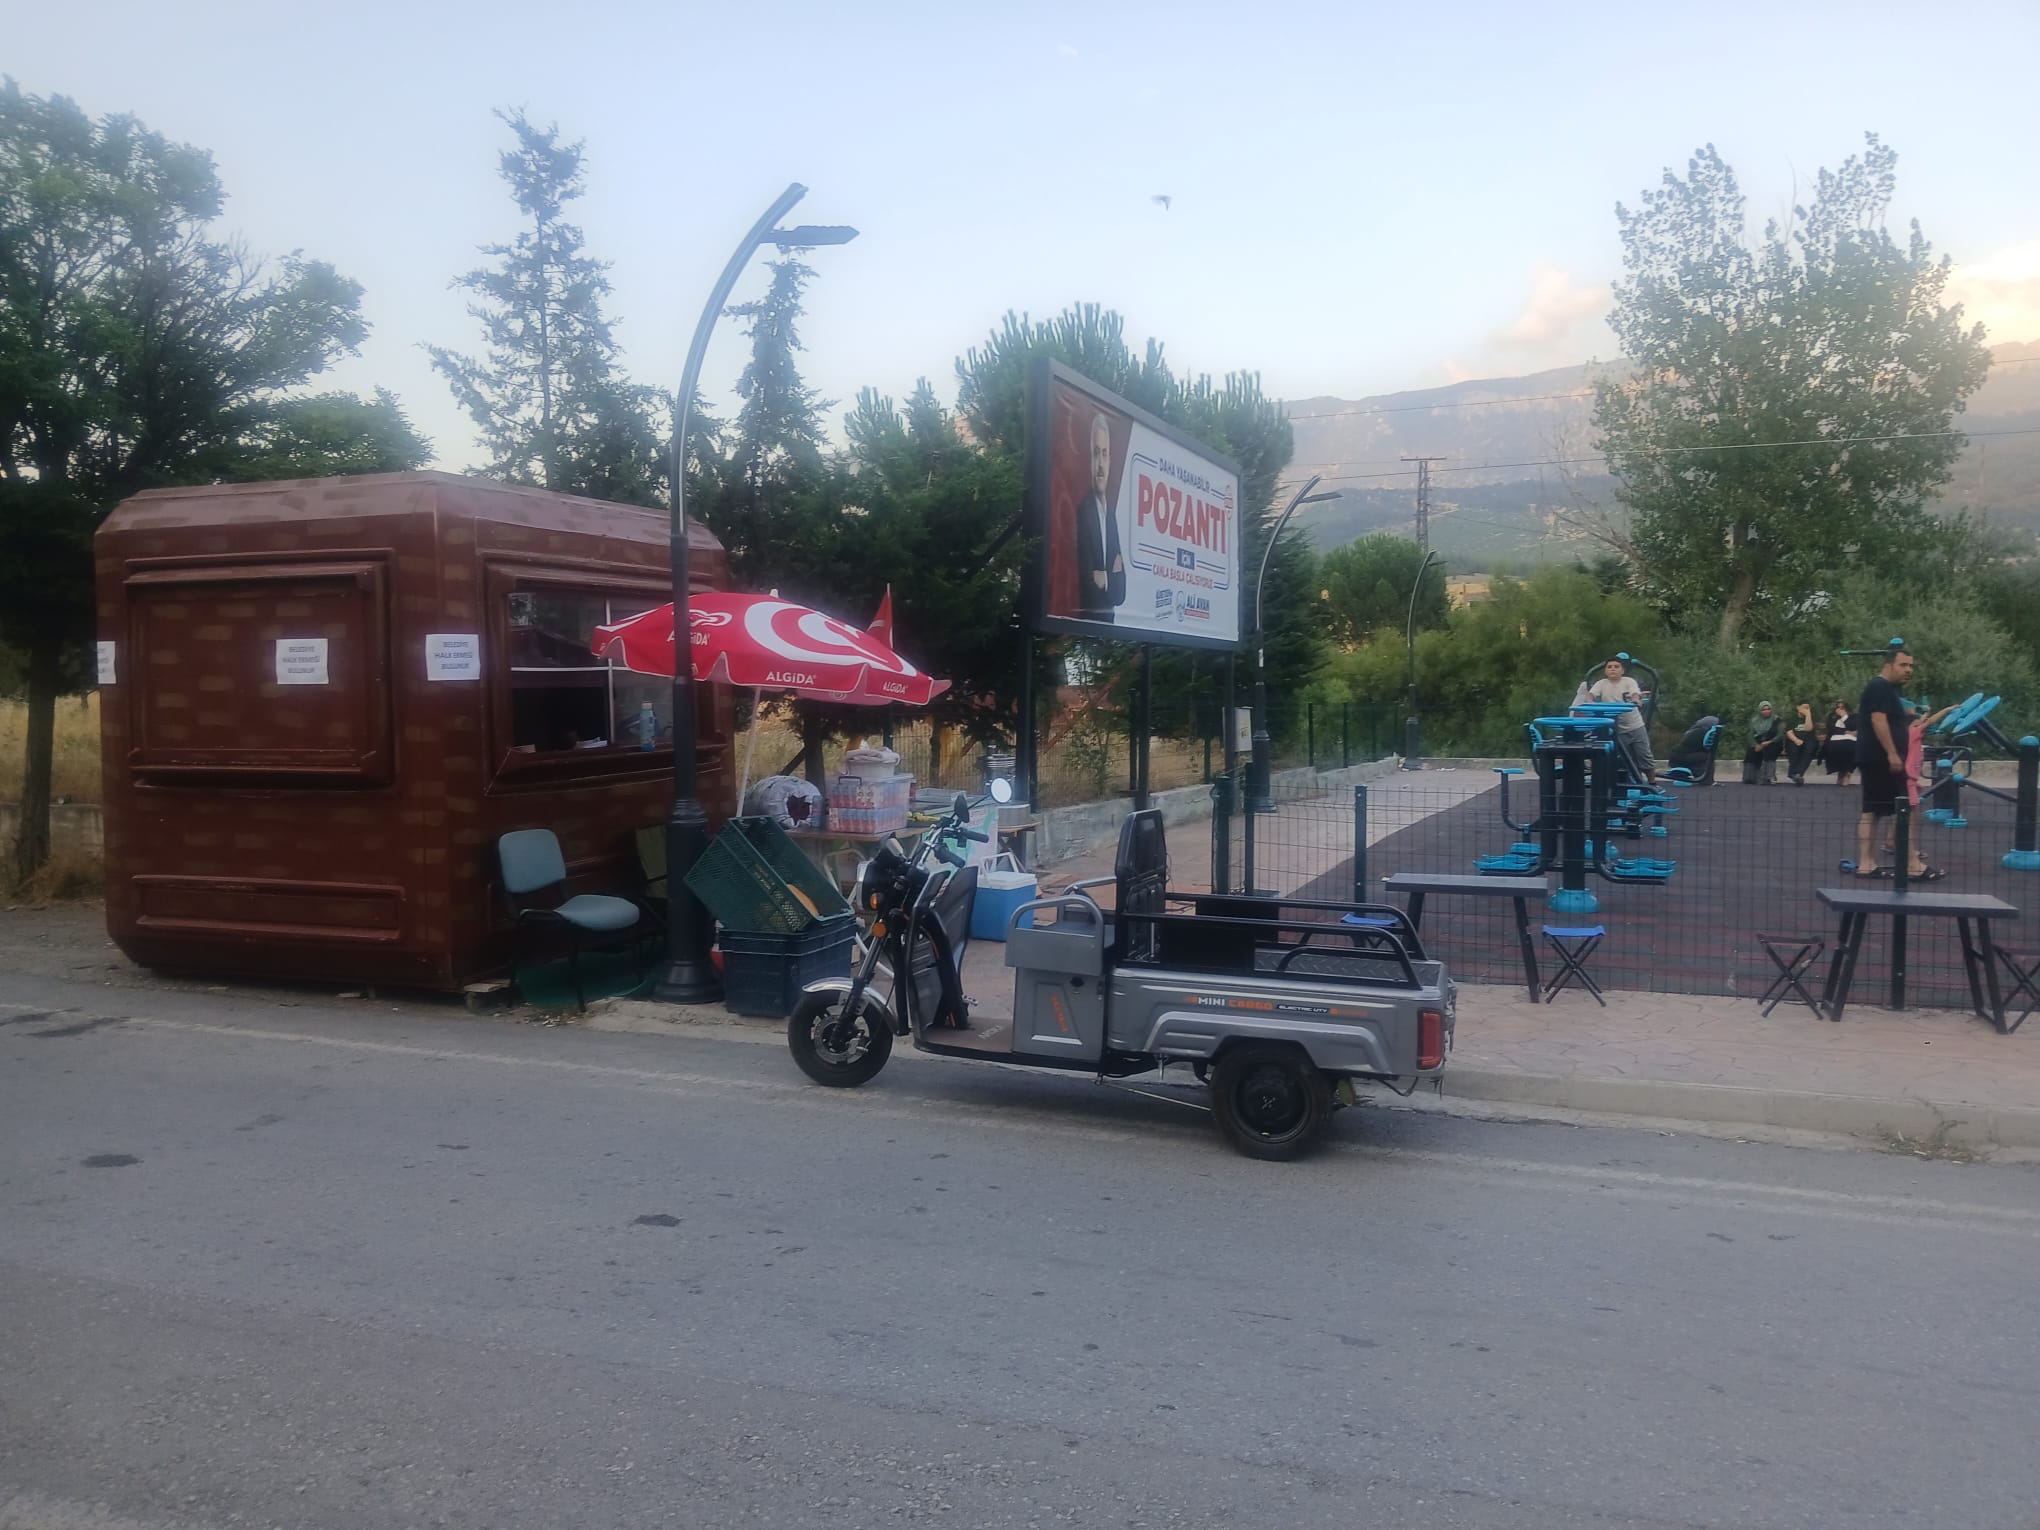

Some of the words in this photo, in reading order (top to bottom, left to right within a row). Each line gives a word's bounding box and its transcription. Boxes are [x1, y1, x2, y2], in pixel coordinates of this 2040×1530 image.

[1159, 458, 1175, 477] DAHA
[1138, 473, 1226, 554] POZANTI
[1198, 996, 1226, 1007] MINI
